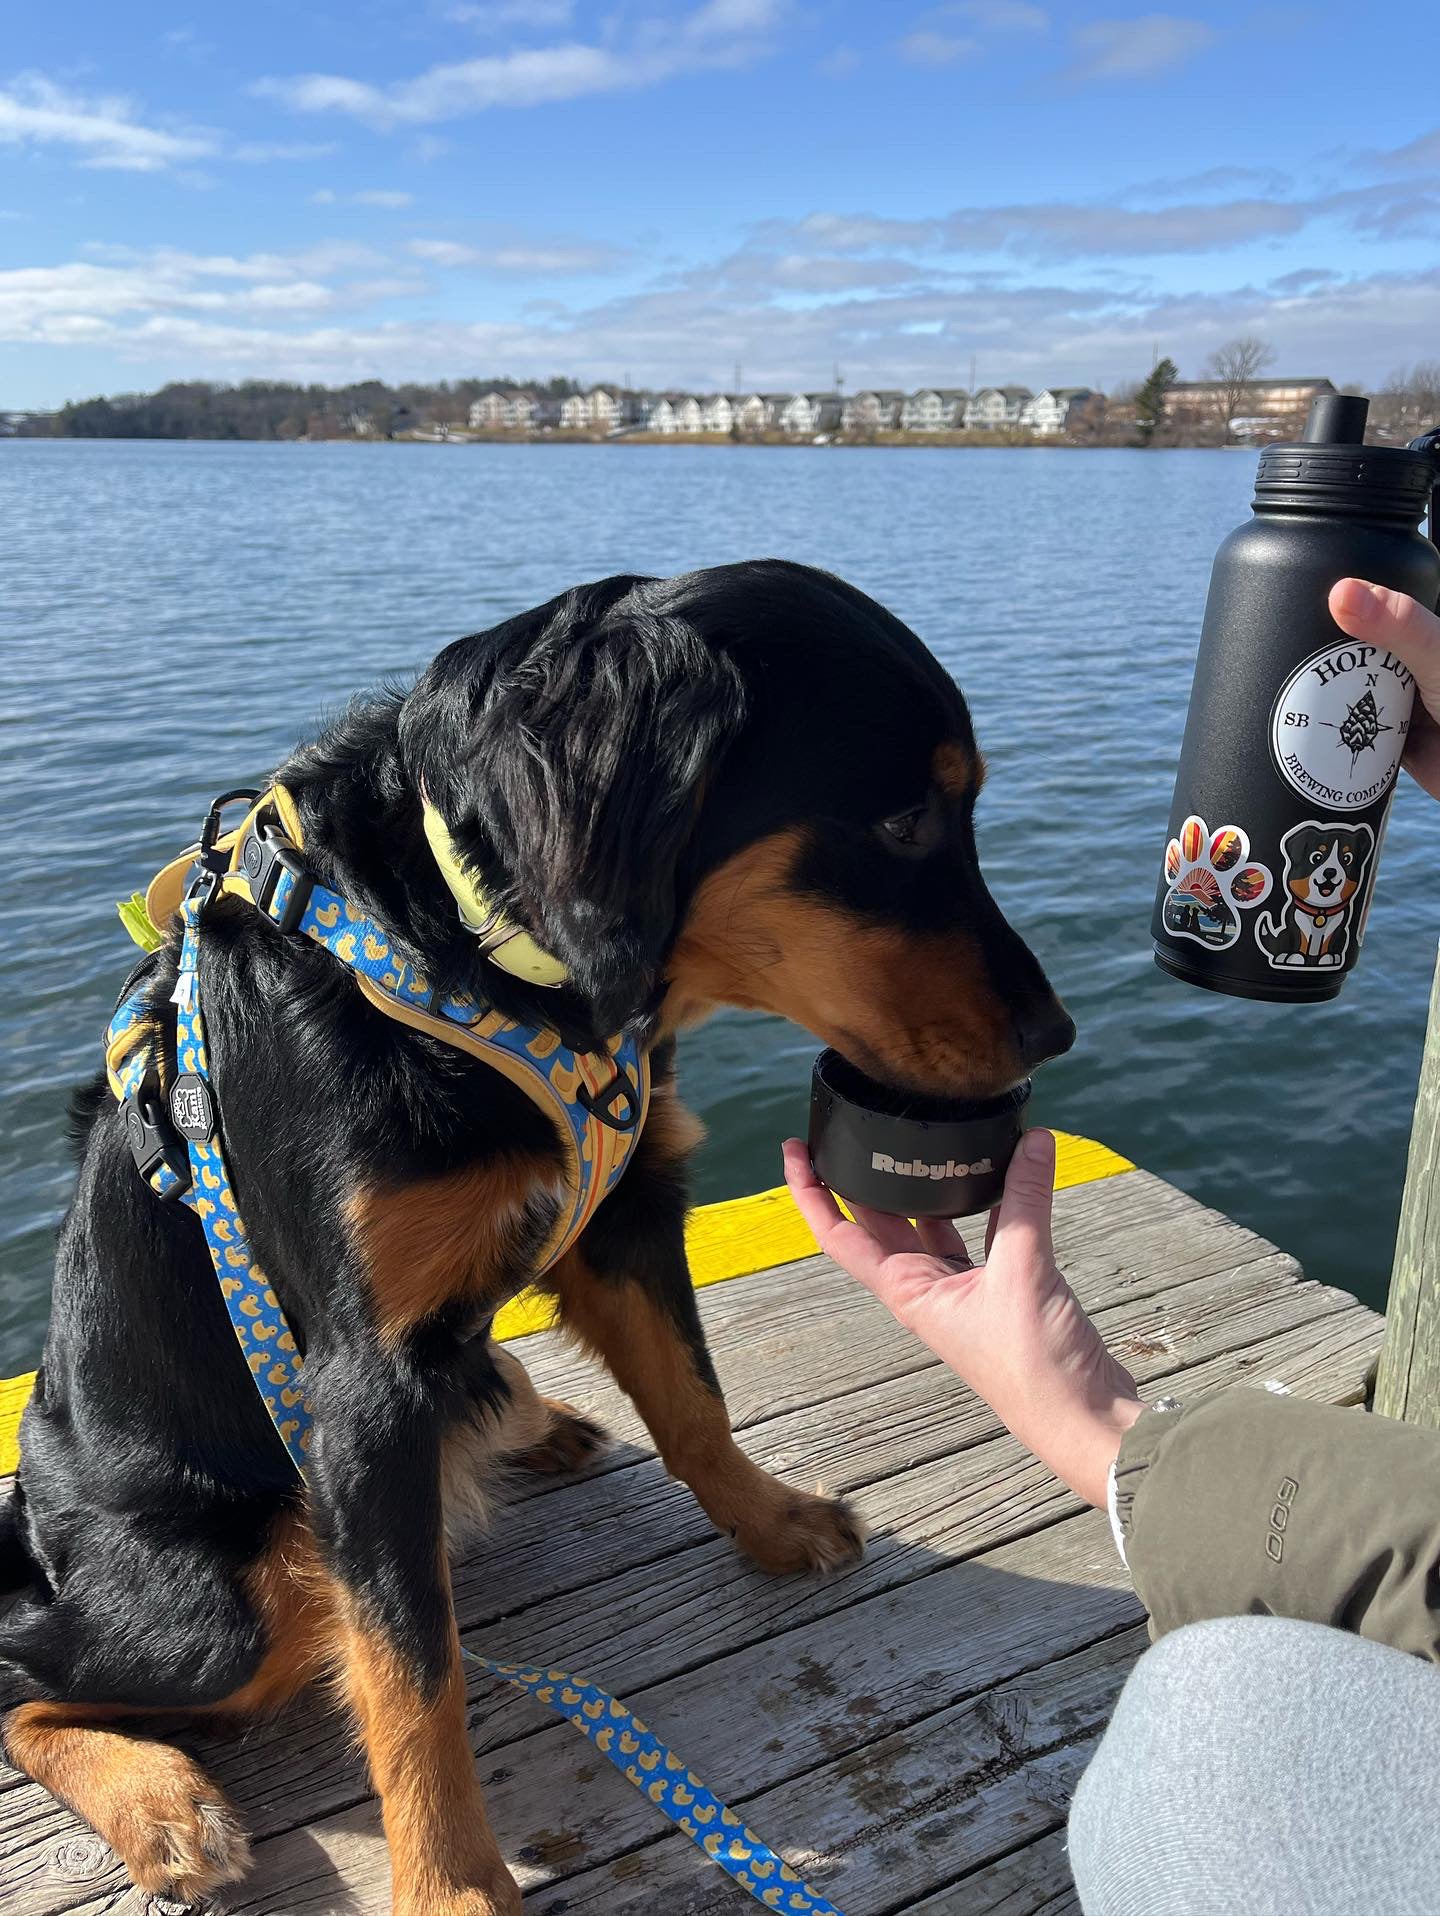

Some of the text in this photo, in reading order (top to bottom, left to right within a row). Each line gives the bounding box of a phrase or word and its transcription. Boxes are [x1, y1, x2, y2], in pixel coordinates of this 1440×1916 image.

[1311, 647, 1377, 686] HOP
[1365, 673, 1379, 687] N
[1284, 712, 1310, 728] SB
[1285, 752, 1396, 803] BREWING COMPANY
[188, 1088, 202, 1127] Kani
